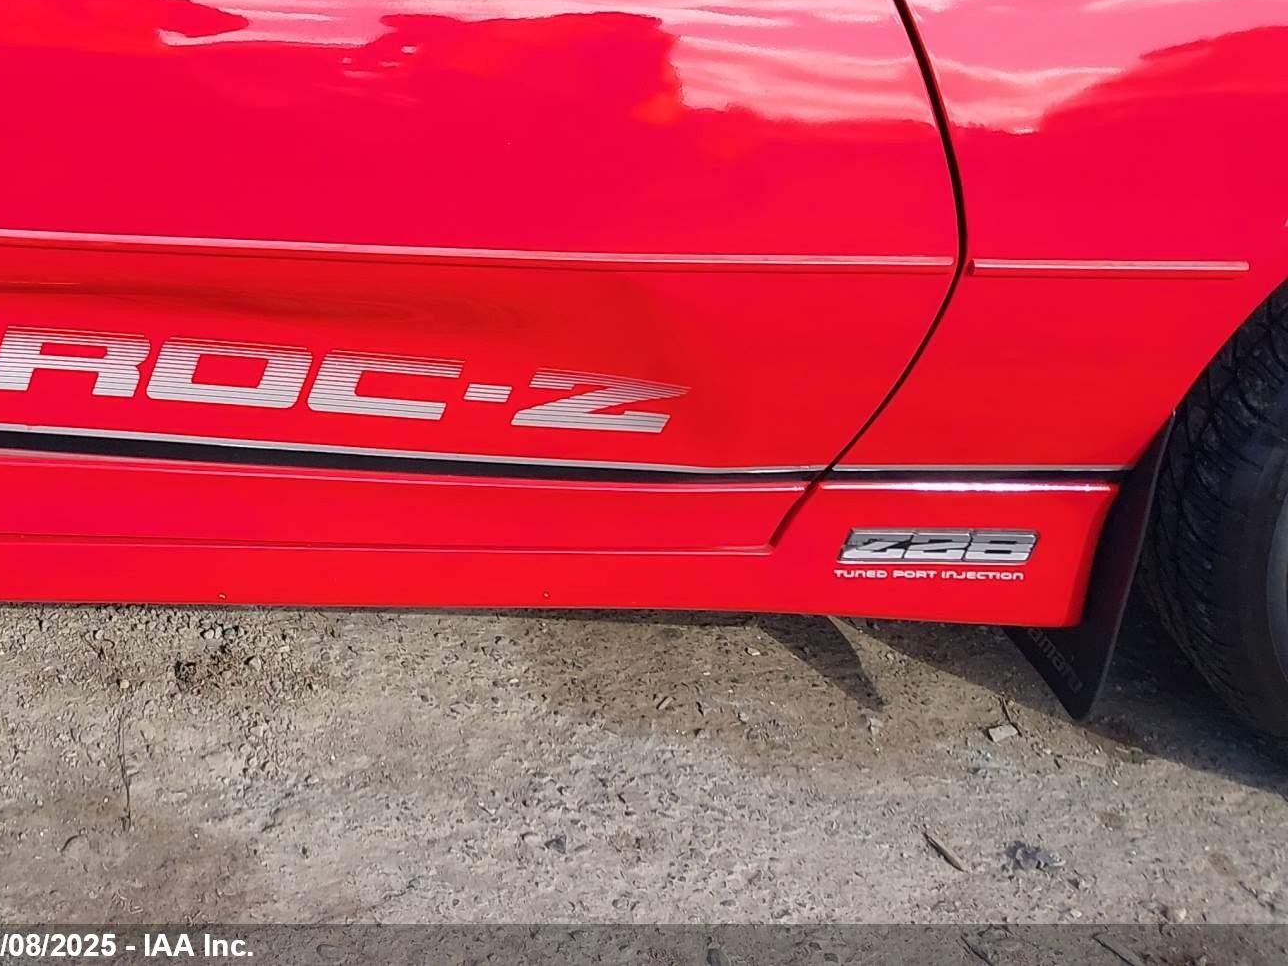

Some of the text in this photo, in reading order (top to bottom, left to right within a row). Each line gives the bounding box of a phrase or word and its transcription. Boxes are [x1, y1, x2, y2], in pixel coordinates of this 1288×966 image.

[838, 529, 1039, 565] Z28
[833, 569, 1025, 581] TUNED PORT INJECTION
